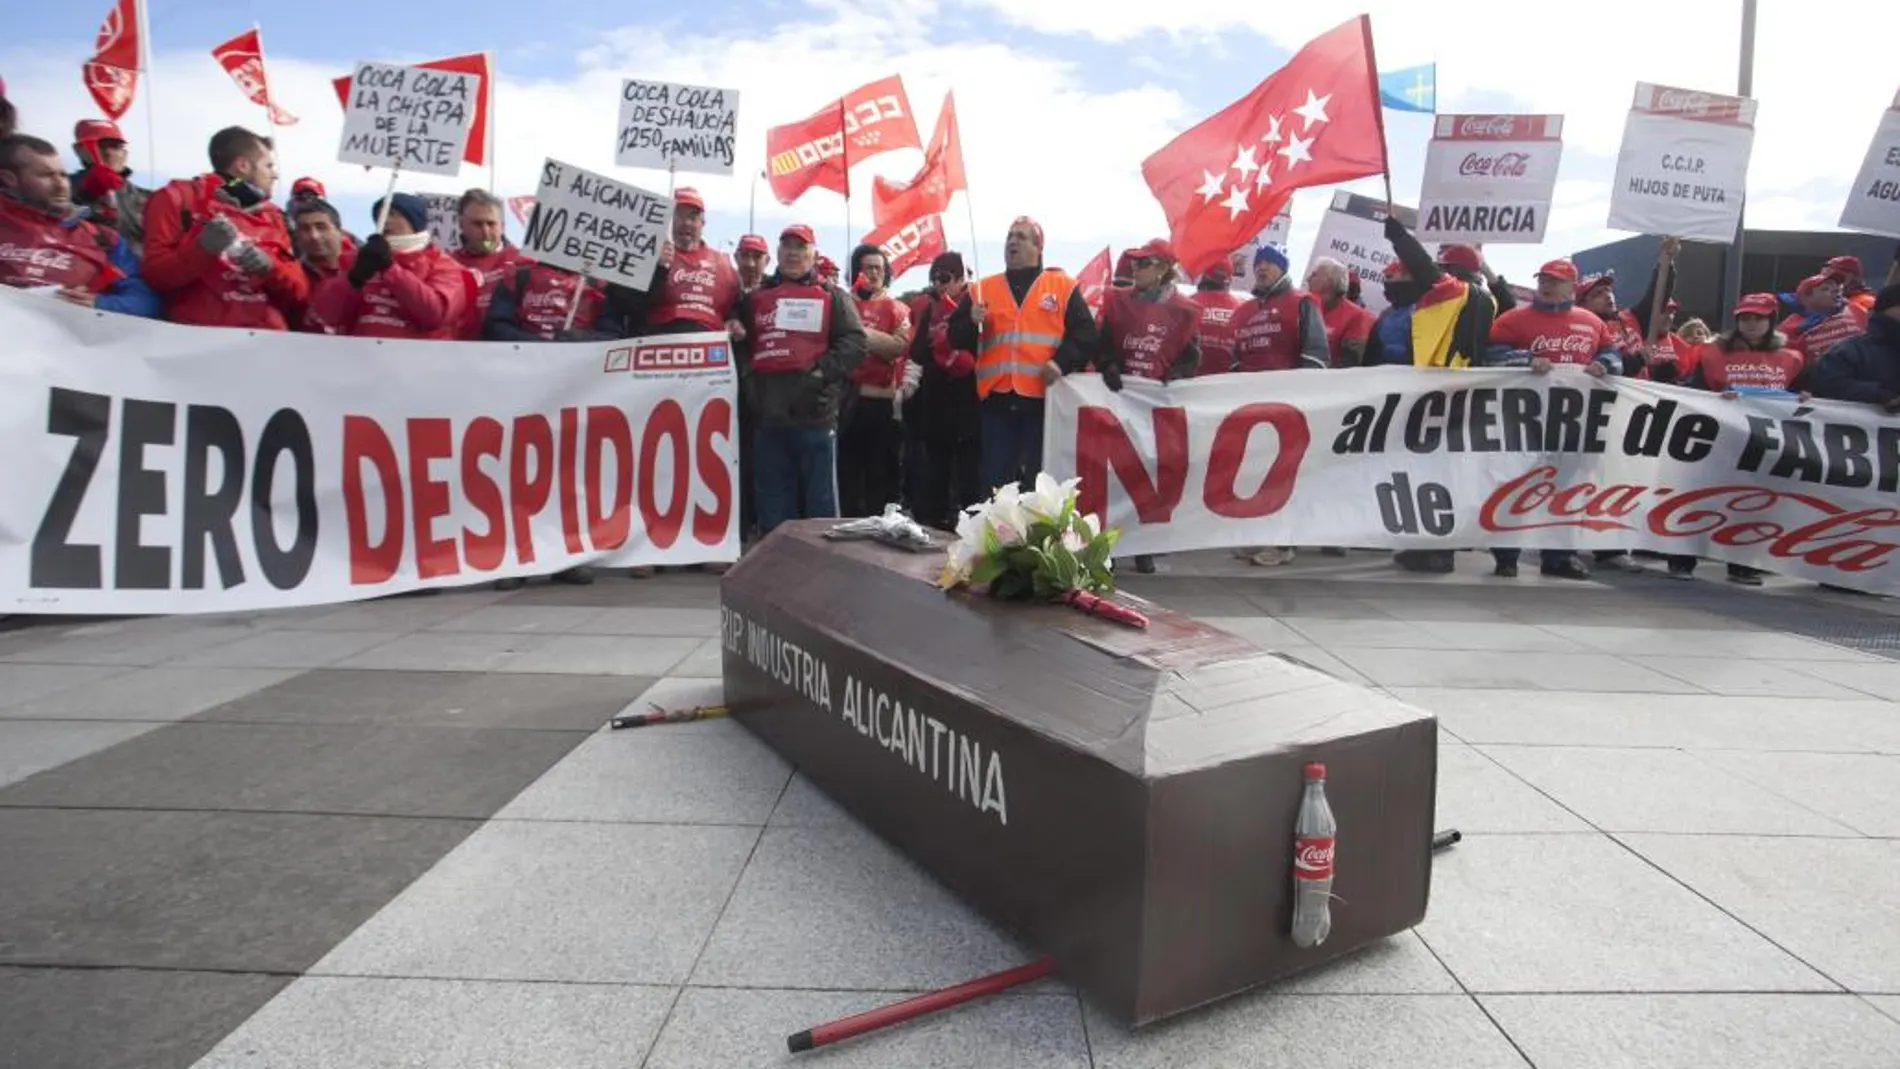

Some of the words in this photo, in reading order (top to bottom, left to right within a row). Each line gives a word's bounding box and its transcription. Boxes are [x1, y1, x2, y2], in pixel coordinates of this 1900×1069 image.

[357, 65, 405, 92] COCA
[412, 72, 468, 100] COLA
[624, 81, 669, 104] COCA
[676, 87, 724, 109] COLA
[355, 89, 379, 111] LA
[375, 116, 398, 133] DE
[406, 119, 428, 136] LA
[619, 127, 663, 153] 1250
[344, 133, 456, 165] MUERTE
[1629, 177, 1669, 197] HIJOS
[1673, 183, 1691, 199] DE
[1694, 186, 1726, 204] PUTA
[523, 201, 568, 254] NO
[1425, 205, 1535, 233] AVARICIA
[563, 235, 646, 277] BEBE
[1330, 239, 1349, 253] NO
[1352, 246, 1367, 259] AL
[638, 347, 705, 366] CCOO
[1076, 403, 1311, 528] NO
[1332, 393, 1402, 454] al
[1403, 387, 1618, 453] CIERRE
[1622, 399, 1720, 463] de
[29, 386, 319, 590] ZERO
[342, 398, 732, 585] DESPIDOS
[1375, 471, 1455, 536] de
[1479, 465, 1900, 572] Coca-Cola
[747, 619, 832, 711] INDUSTRIA
[842, 675, 1007, 826] ALICANTINA
